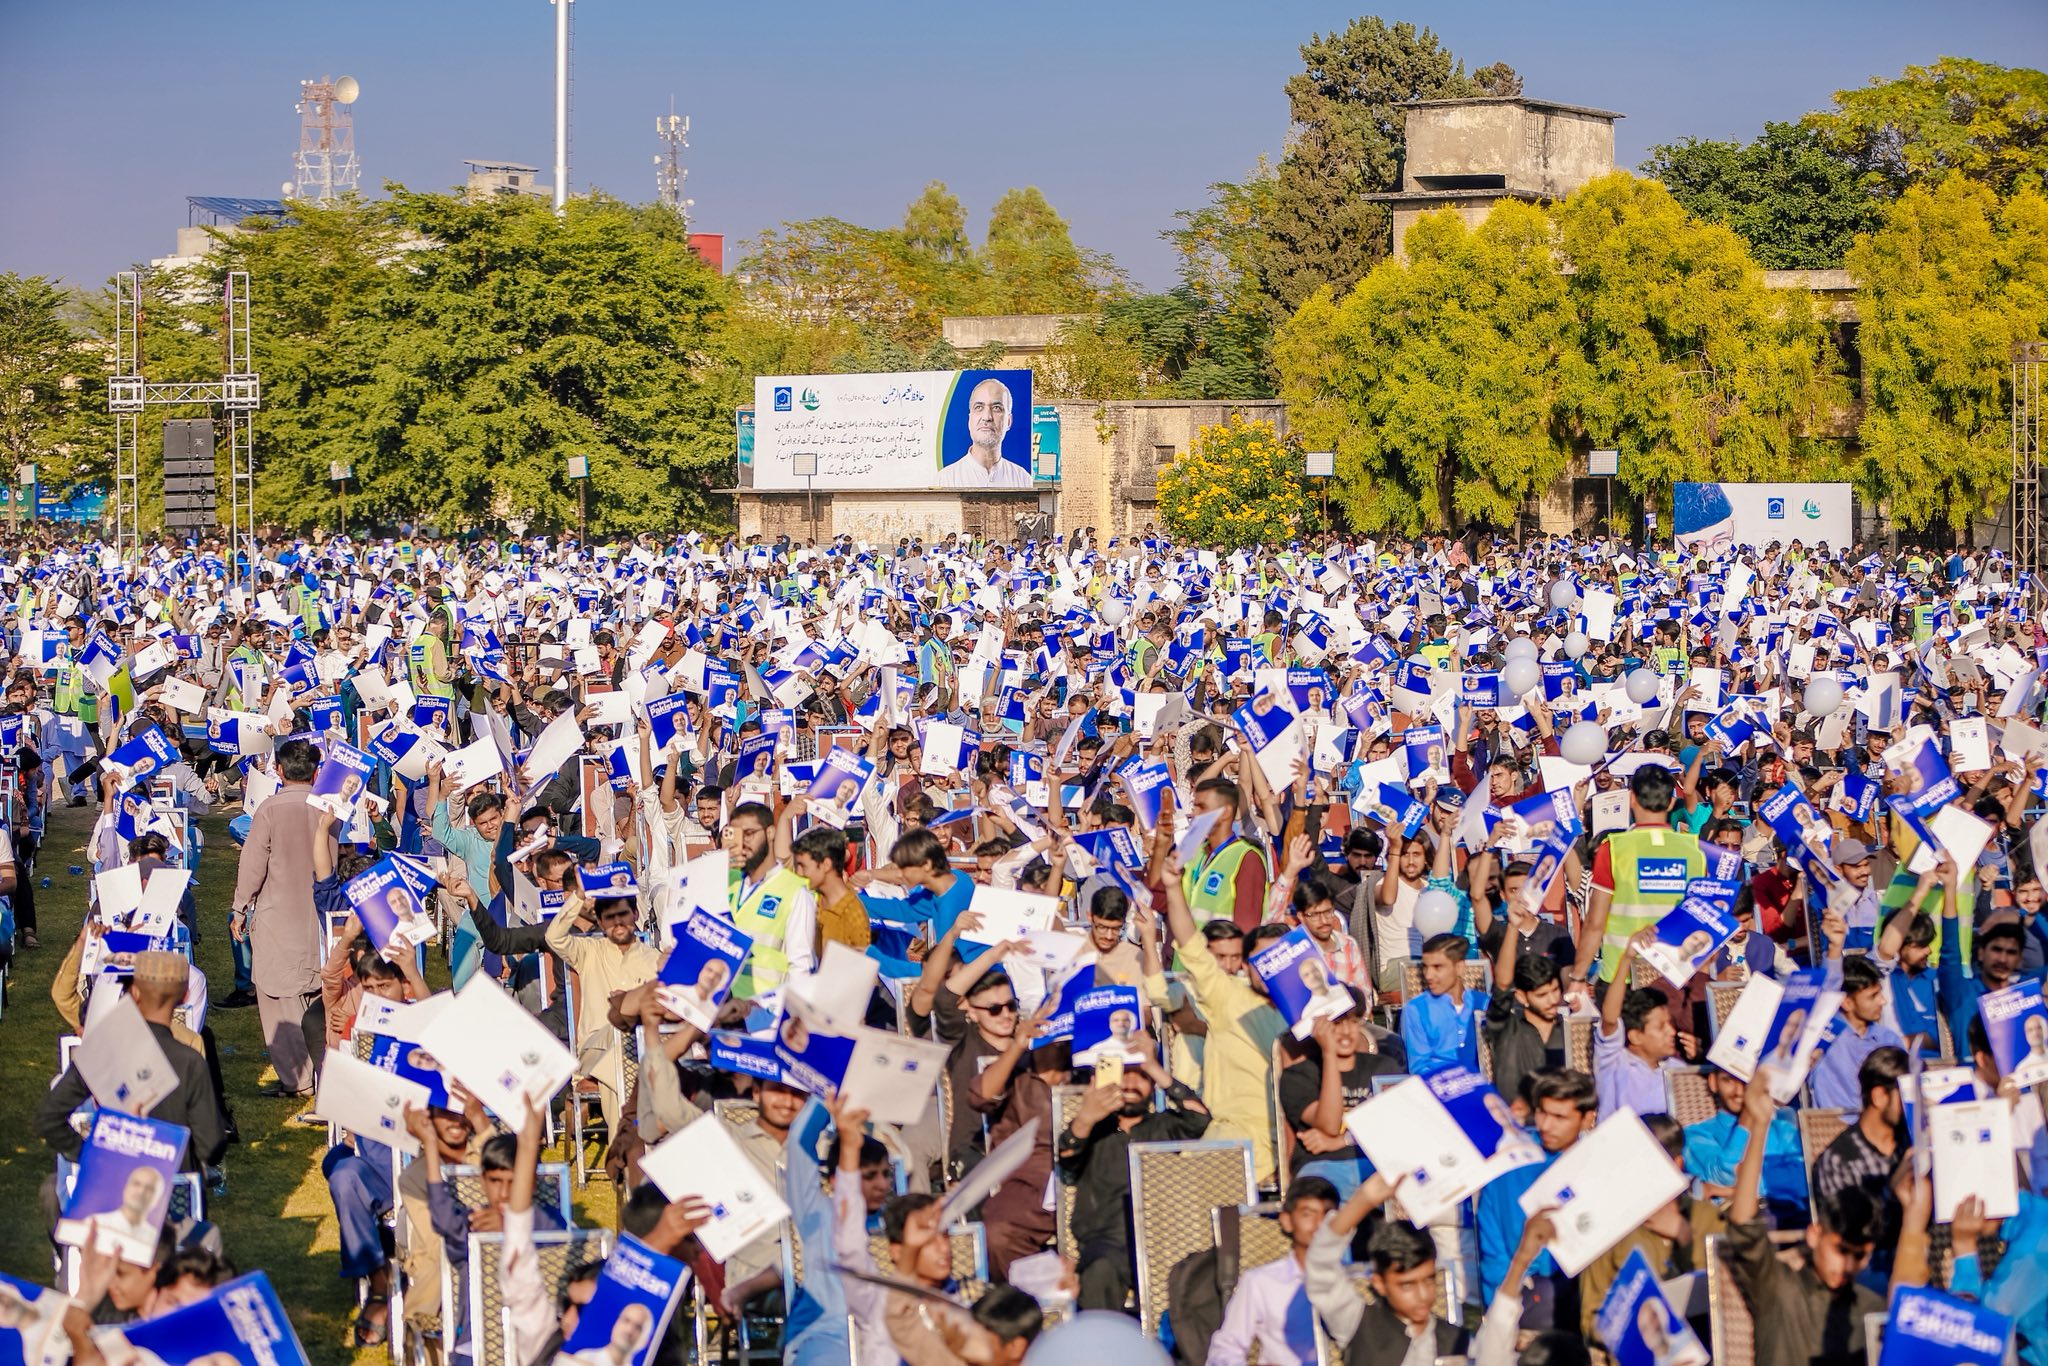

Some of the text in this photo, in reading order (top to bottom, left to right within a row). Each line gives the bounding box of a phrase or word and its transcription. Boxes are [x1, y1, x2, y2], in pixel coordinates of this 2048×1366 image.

[1288, 676, 1322, 684] Pakistan
[1543, 666, 1574, 674] Pakistan
[312, 701, 340, 709] Pakistan
[418, 700, 448, 708] Pakistan
[650, 700, 684, 717] Pakistan
[763, 716, 792, 724] Pakistan
[143, 732, 168, 761] Pakistan
[1406, 733, 1442, 744] Pakistan
[331, 748, 371, 774] Pakistan
[346, 747, 364, 760] Rebuild
[827, 752, 868, 780] Pakistan
[1132, 772, 1168, 793] Pakistan
[1764, 790, 1800, 820] Pakistan
[349, 870, 398, 902] Pakistan
[357, 870, 377, 889] Rebuild
[402, 872, 428, 894] istan
[1688, 884, 1734, 896] Pakistan
[1681, 898, 1729, 937] Pakistan
[684, 922, 744, 960] Pakistan
[1256, 938, 1312, 978] Pakistan
[1074, 994, 1136, 1014] Pakistan
[1986, 993, 2042, 1020] Pakistan
[717, 1048, 779, 1074] Pakistan
[94, 1124, 176, 1162] Pakistan
[604, 1254, 671, 1300] Pakistan
[1896, 1303, 2002, 1356] Pakistan
